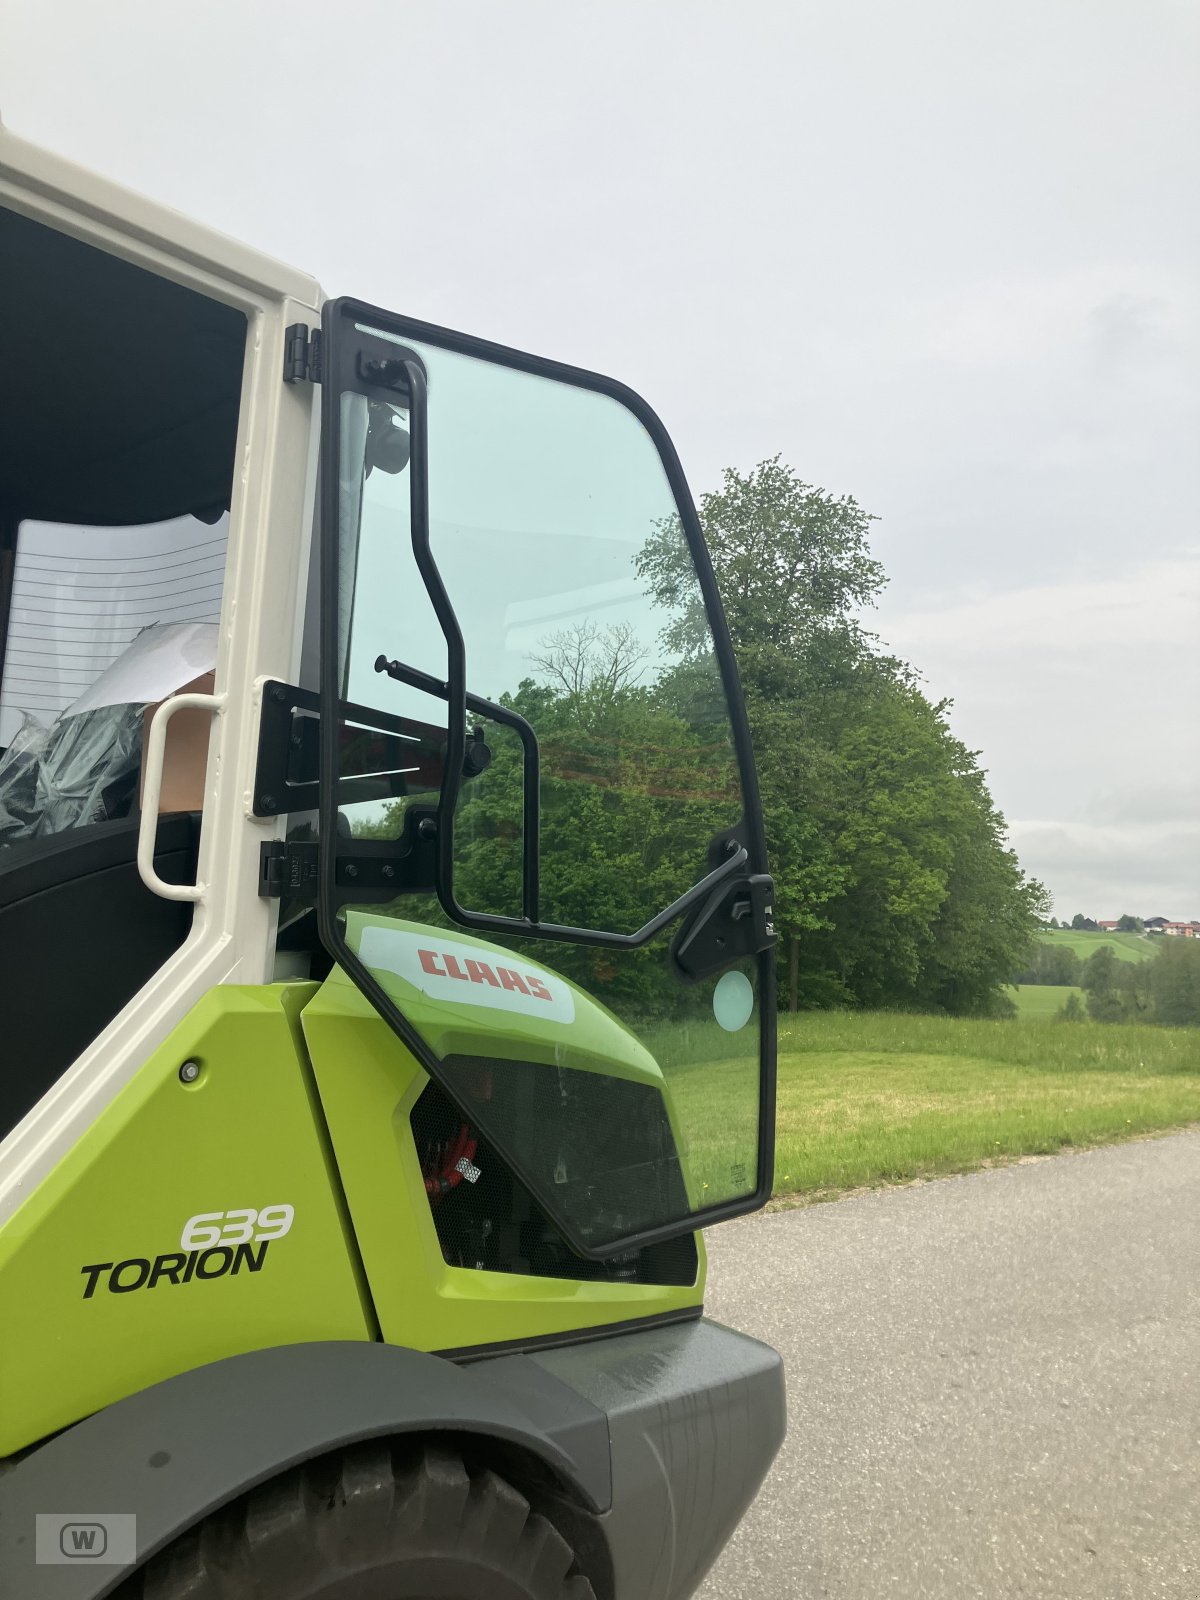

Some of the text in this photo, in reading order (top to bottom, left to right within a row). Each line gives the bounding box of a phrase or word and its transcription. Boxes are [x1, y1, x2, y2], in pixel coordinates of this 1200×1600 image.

[417, 948, 553, 1001] CLAAS
[180, 1204, 295, 1251] 639
[80, 1240, 270, 1300] TORION
